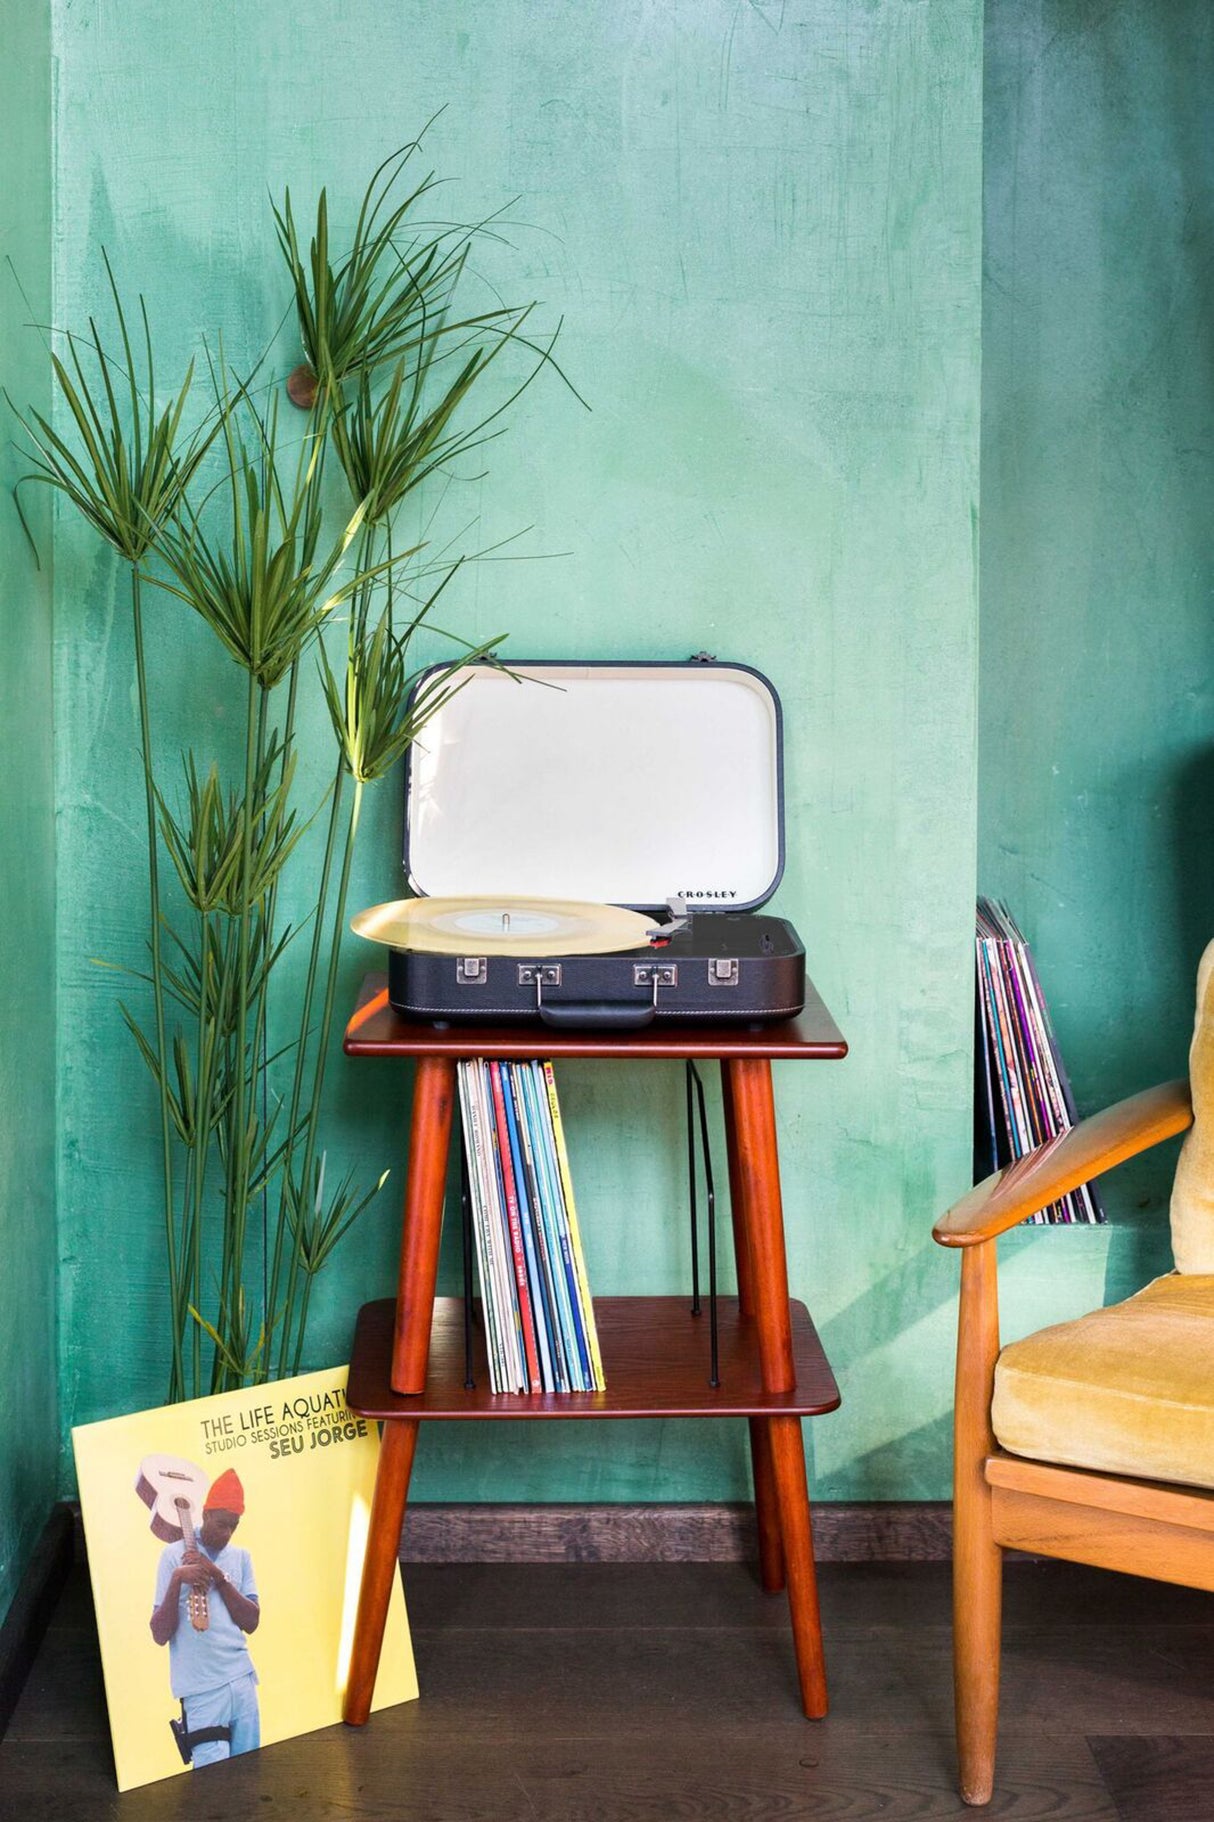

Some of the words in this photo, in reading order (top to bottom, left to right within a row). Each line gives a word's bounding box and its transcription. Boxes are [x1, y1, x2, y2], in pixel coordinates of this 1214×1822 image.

[513, 1231, 521, 1253] RADIO
[200, 1415, 234, 1439] THE
[240, 1405, 275, 1430] LIFE
[282, 1388, 346, 1421] AQUAT
[205, 1434, 247, 1454] STUDIO
[250, 1421, 304, 1443] SESSIONS
[269, 1435, 305, 1459] SEU
[310, 1420, 368, 1449] JORGE
